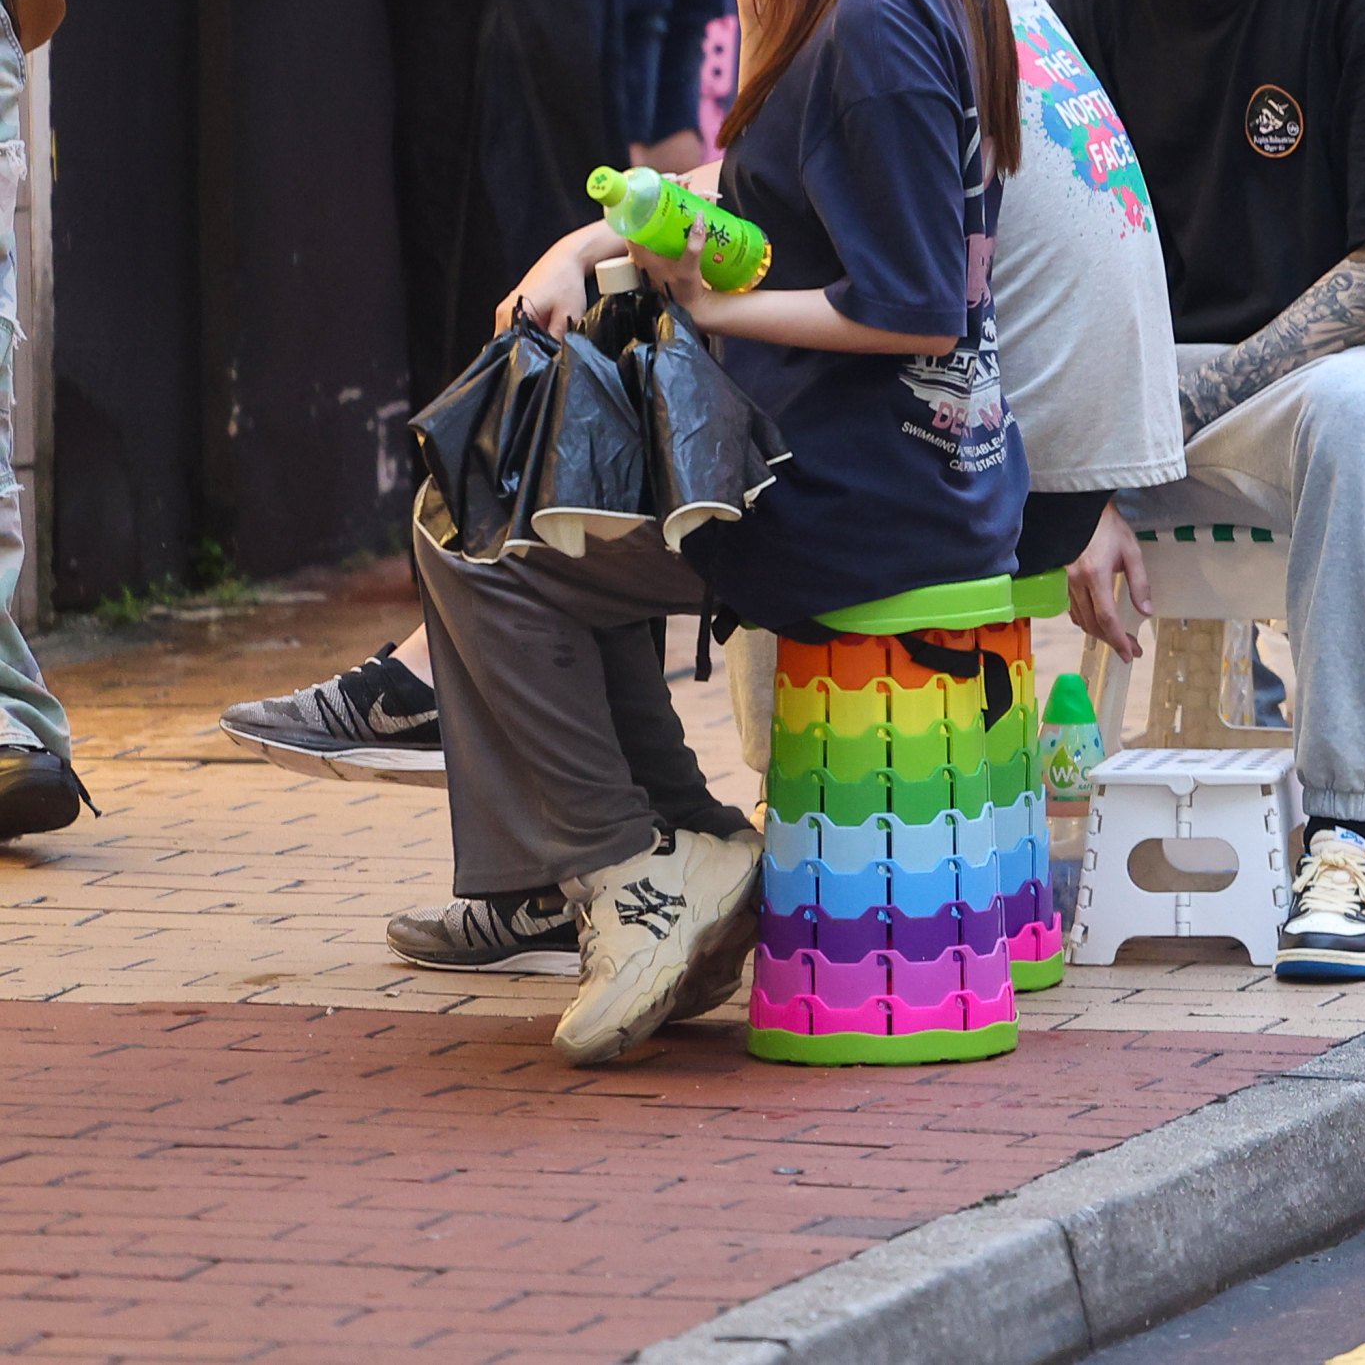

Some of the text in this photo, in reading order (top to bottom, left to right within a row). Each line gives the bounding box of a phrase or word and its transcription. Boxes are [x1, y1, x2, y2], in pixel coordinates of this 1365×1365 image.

[1034, 49, 1080, 82] THE
[1089, 134, 1135, 173] FACE
[901, 421, 957, 455] SWIMMING
